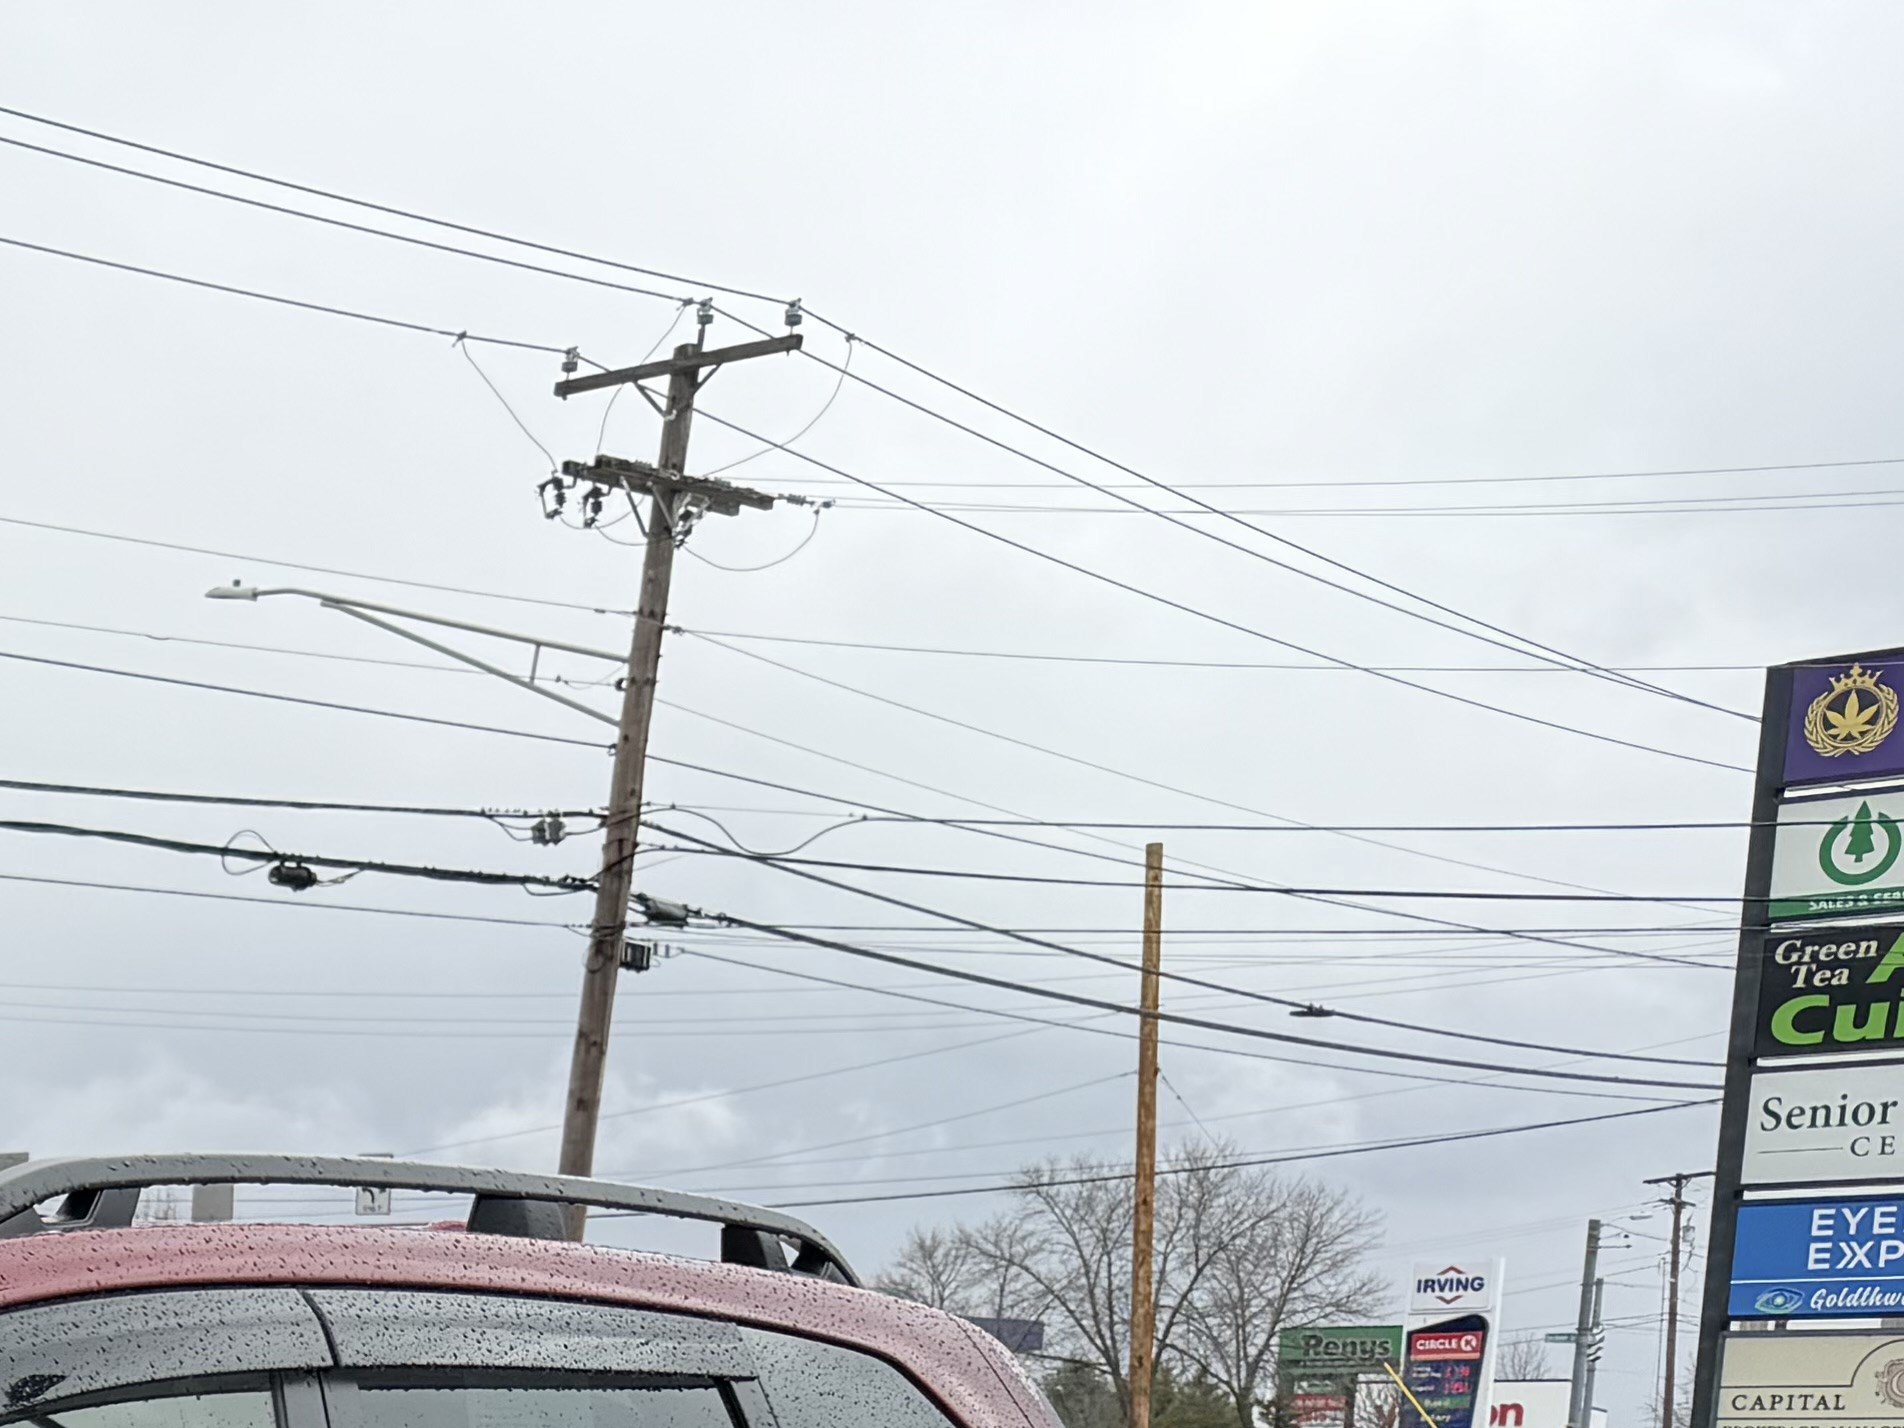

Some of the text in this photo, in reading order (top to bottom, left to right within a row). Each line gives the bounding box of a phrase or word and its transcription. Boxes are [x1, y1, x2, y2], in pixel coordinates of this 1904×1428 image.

[1809, 896, 1853, 911] SALES
[1873, 890, 1904, 905] SER
[1775, 939, 1878, 965] Green
[1791, 964, 1849, 988] Tea
[1760, 1093, 1898, 1132] Senior
[1850, 1135, 1896, 1157] CE
[1811, 1206, 1904, 1236] EYE
[1416, 1276, 1485, 1294] IRVING
[1300, 1332, 1392, 1363] Renys
[1415, 1335, 1477, 1351] CIRCLE K
[1731, 1394, 1846, 1411] CAPITAL
